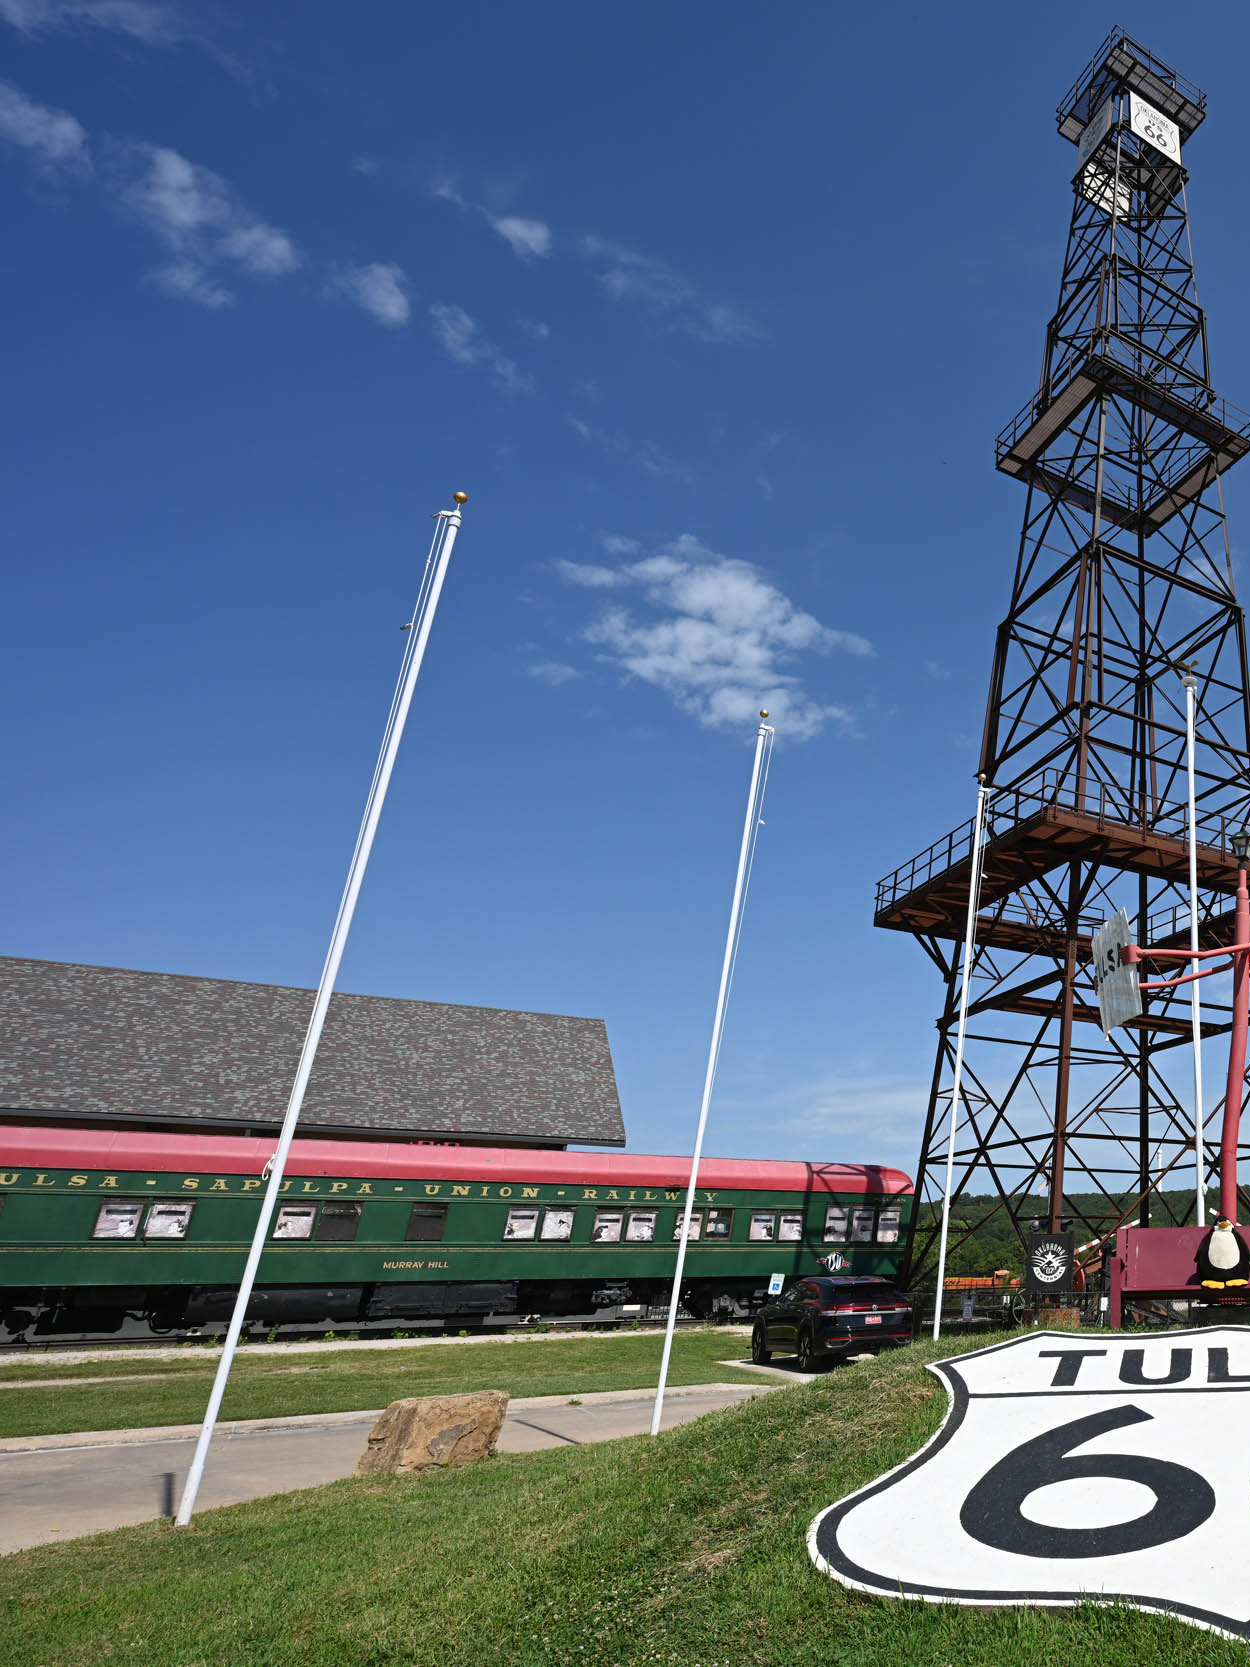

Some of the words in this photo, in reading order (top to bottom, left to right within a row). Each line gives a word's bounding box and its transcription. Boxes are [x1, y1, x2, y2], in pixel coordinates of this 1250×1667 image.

[1144, 125, 1167, 147] 66
[182, 1178, 373, 1194] SAPULPA
[424, 1184, 541, 1198] UNION
[1034, 1240, 1066, 1257] OKLAHOMA
[383, 1261, 424, 1269] MURRAY
[428, 1261, 448, 1269] HILL
